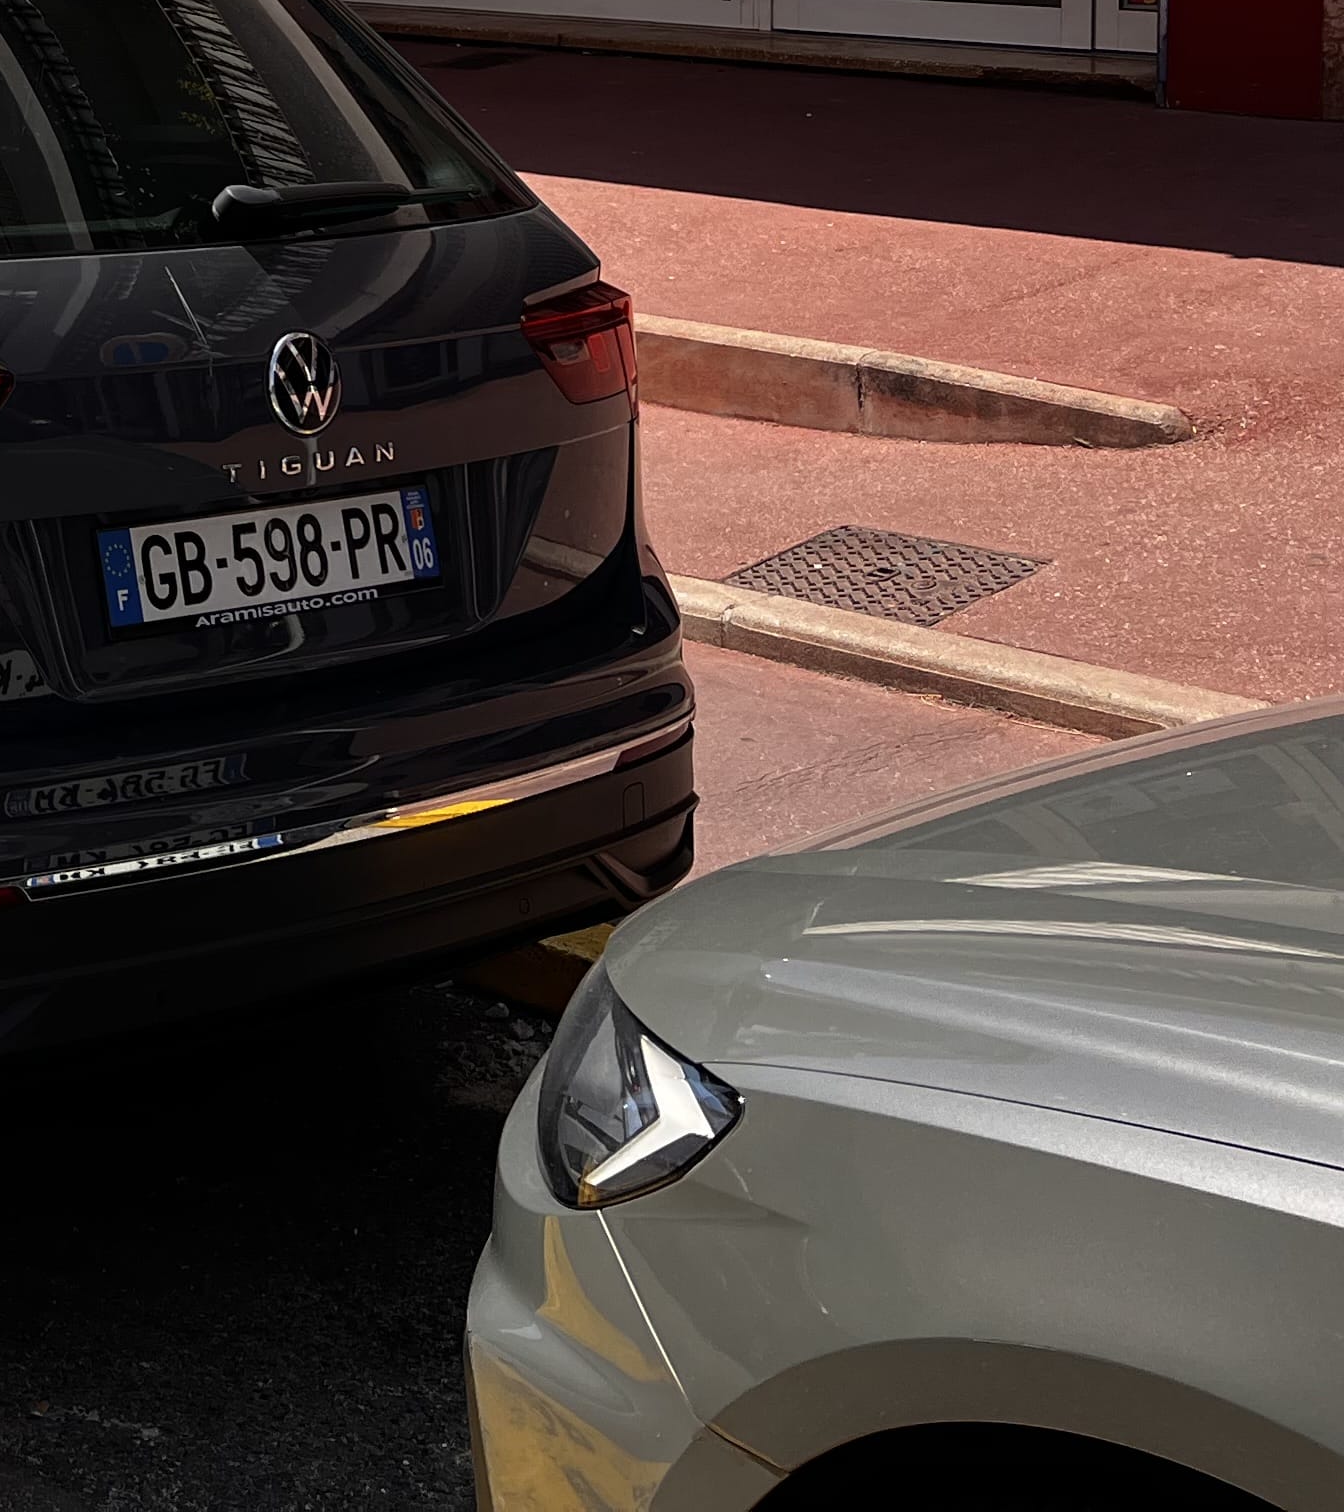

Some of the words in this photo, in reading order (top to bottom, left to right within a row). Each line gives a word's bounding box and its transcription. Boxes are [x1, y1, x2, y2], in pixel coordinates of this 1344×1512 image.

[223, 441, 396, 483] TIGUAN
[141, 503, 407, 610] GB-598-PR
[413, 537, 435, 570] 06
[117, 589, 129, 611] F
[195, 588, 379, 628] Aramisauto.com
